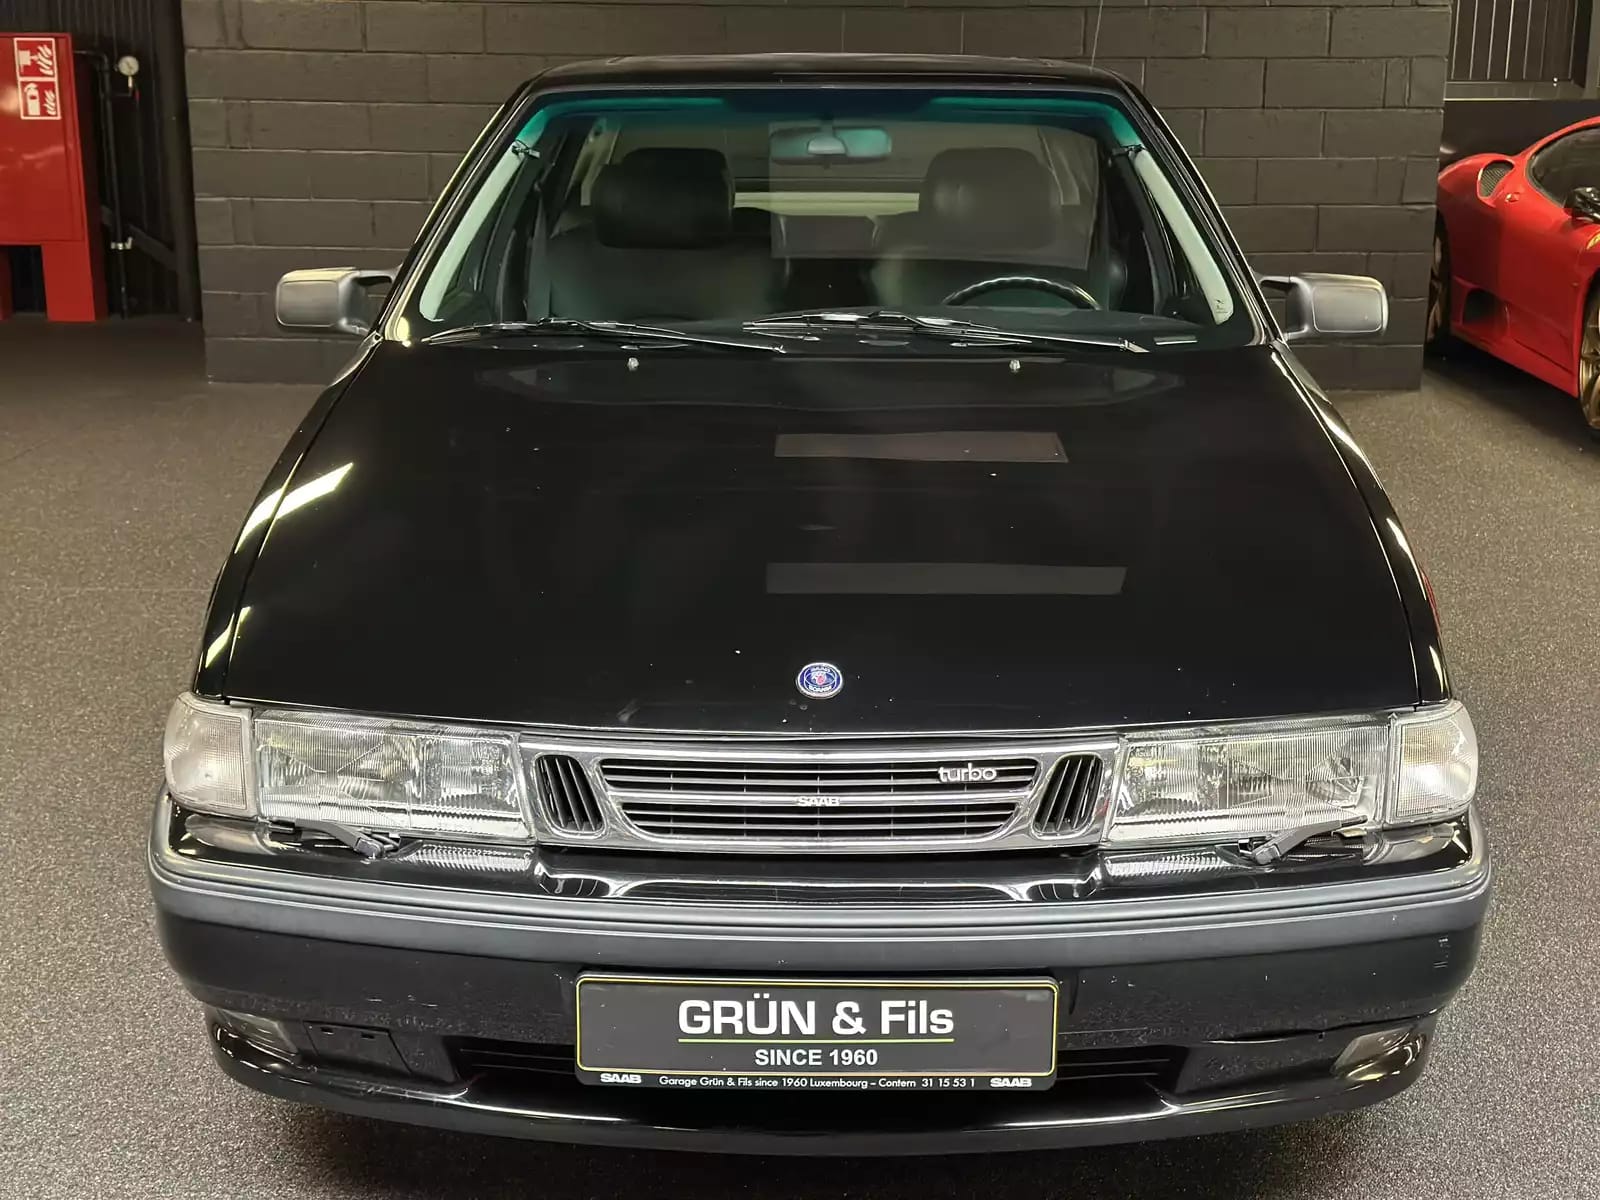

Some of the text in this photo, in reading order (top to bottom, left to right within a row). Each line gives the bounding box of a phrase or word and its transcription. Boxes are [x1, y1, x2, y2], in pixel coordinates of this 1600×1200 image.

[938, 762, 997, 783] turbo
[797, 795, 841, 807] SAAB
[678, 992, 955, 1035] GRÜN & Fils
[754, 1048, 878, 1066] SINCE 1960
[600, 1073, 642, 1084] SAAB
[659, 1075, 698, 1087] Garage
[700, 1077, 724, 1086] Grün
[727, 1077, 736, 1087] &
[738, 1077, 753, 1087] Fils
[754, 1077, 779, 1087] since
[781, 1078, 808, 1087] 1960
[809, 1078, 868, 1089] Luxembourg
[878, 1078, 916, 1088] Contern
[921, 1078, 934, 1087] 31
[938, 1078, 949, 1087] 15
[952, 1078, 967, 1087] 53
[990, 1077, 1032, 1087] SAAB
